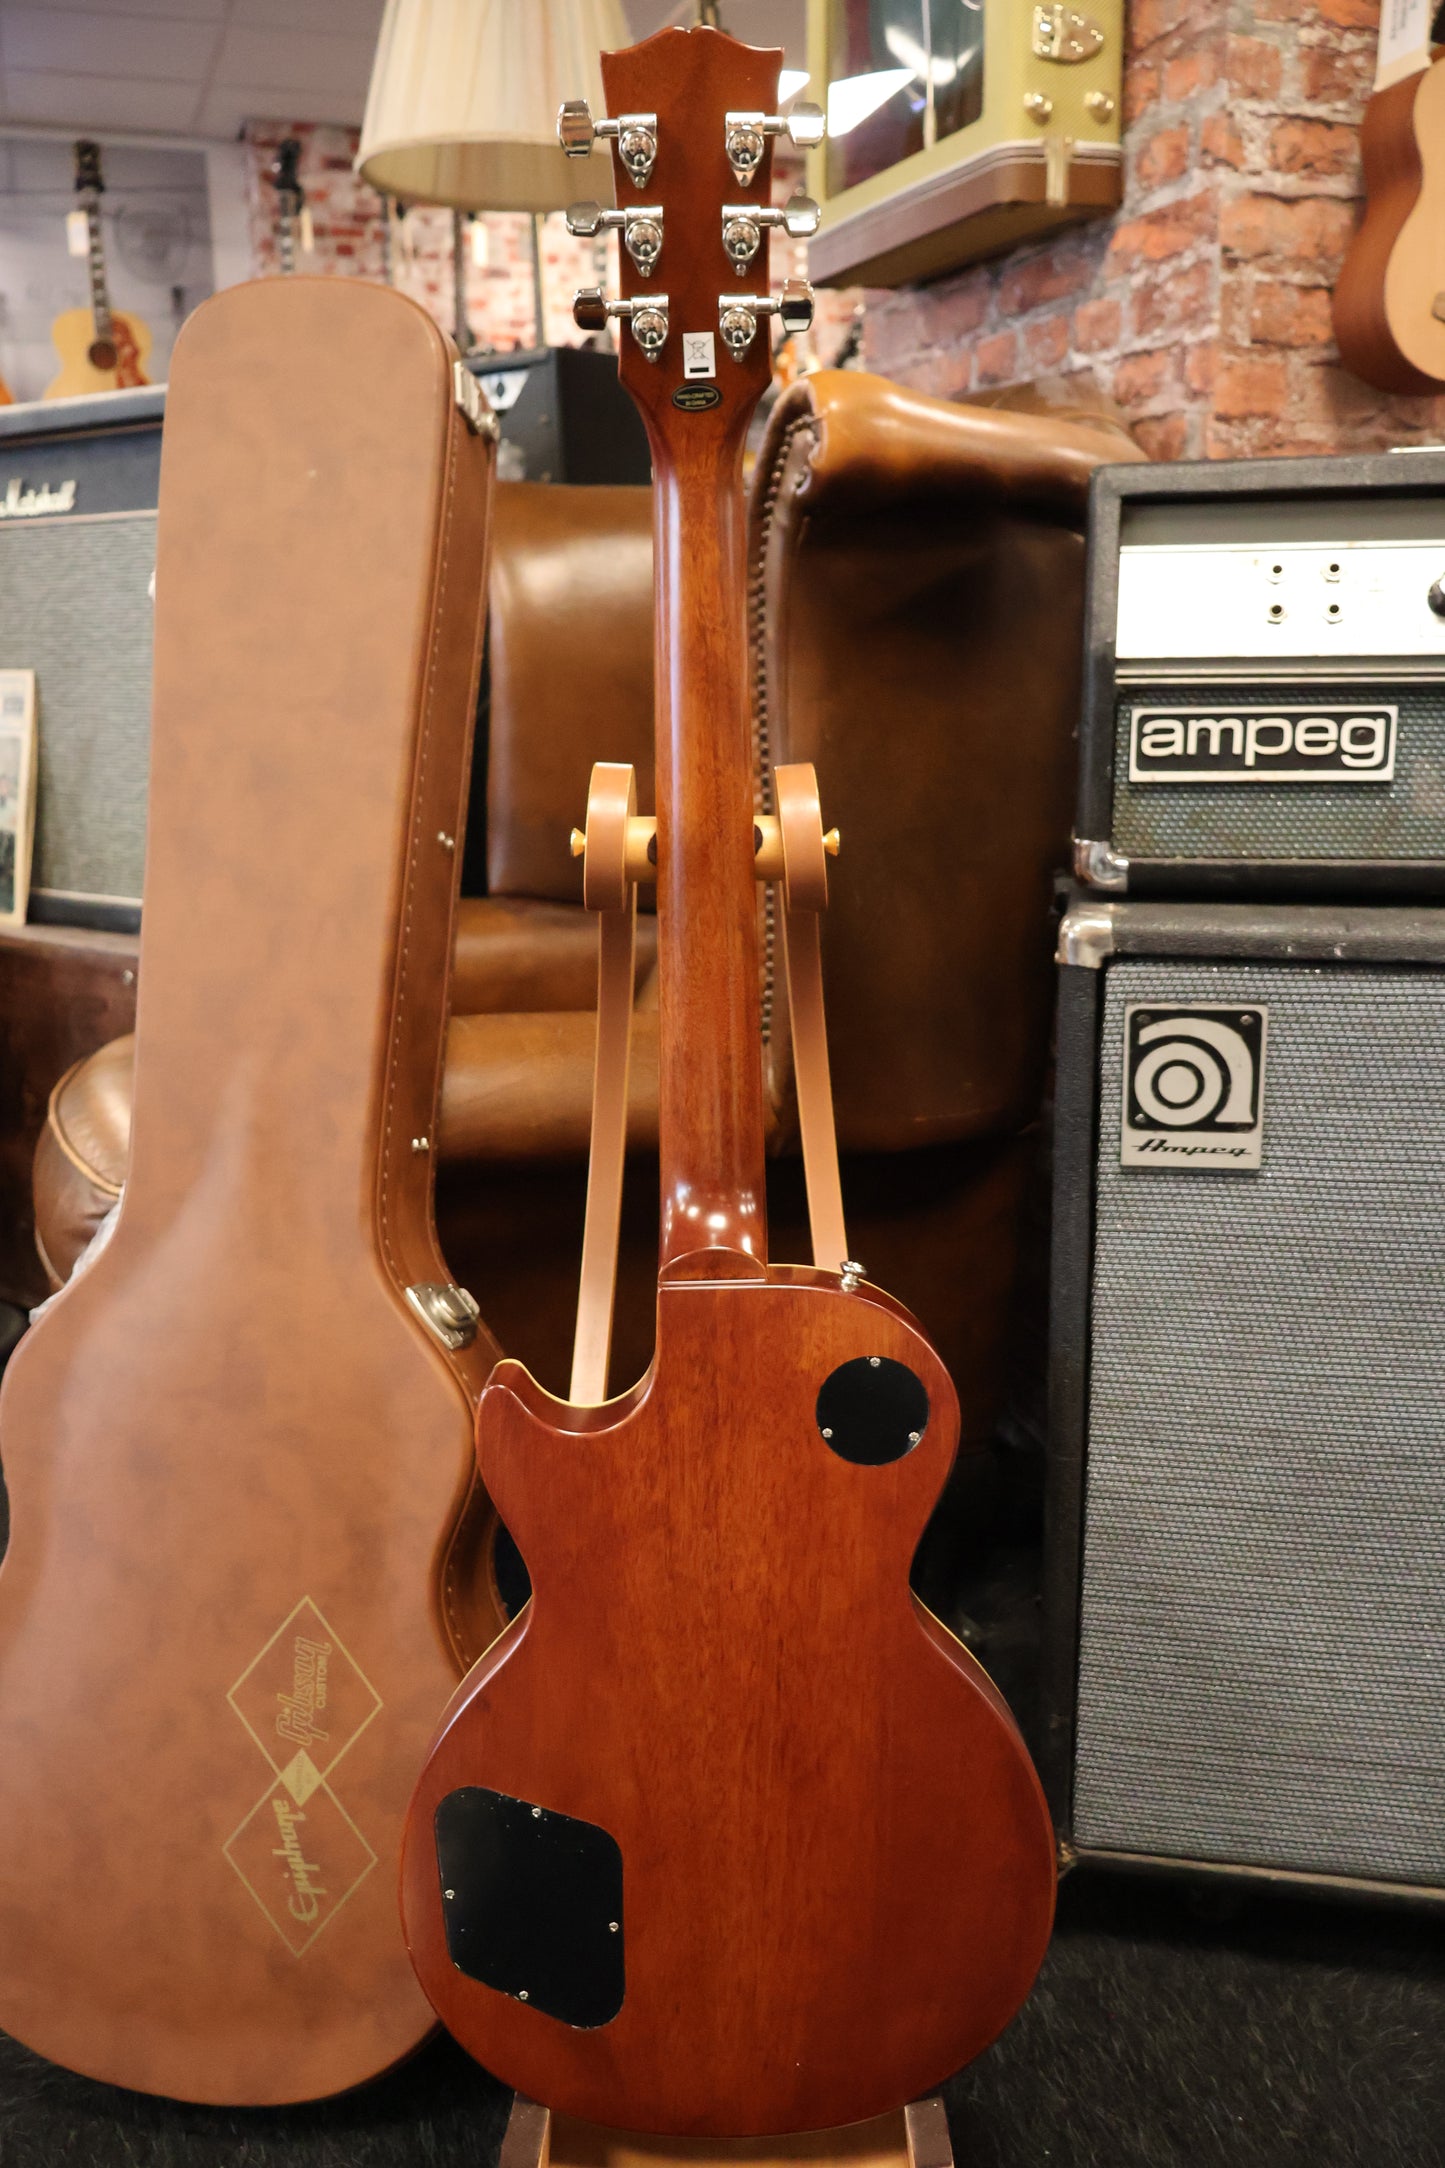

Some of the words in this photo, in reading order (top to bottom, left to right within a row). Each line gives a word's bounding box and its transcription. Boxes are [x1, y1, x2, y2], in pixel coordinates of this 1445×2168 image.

[1140, 716, 1387, 768] ampeg
[1132, 1138, 1252, 1157] Ampeg
[276, 1635, 332, 1745] Gibson
[315, 1654, 328, 1709] CUSTOM
[272, 1798, 328, 1926] Epiphone
